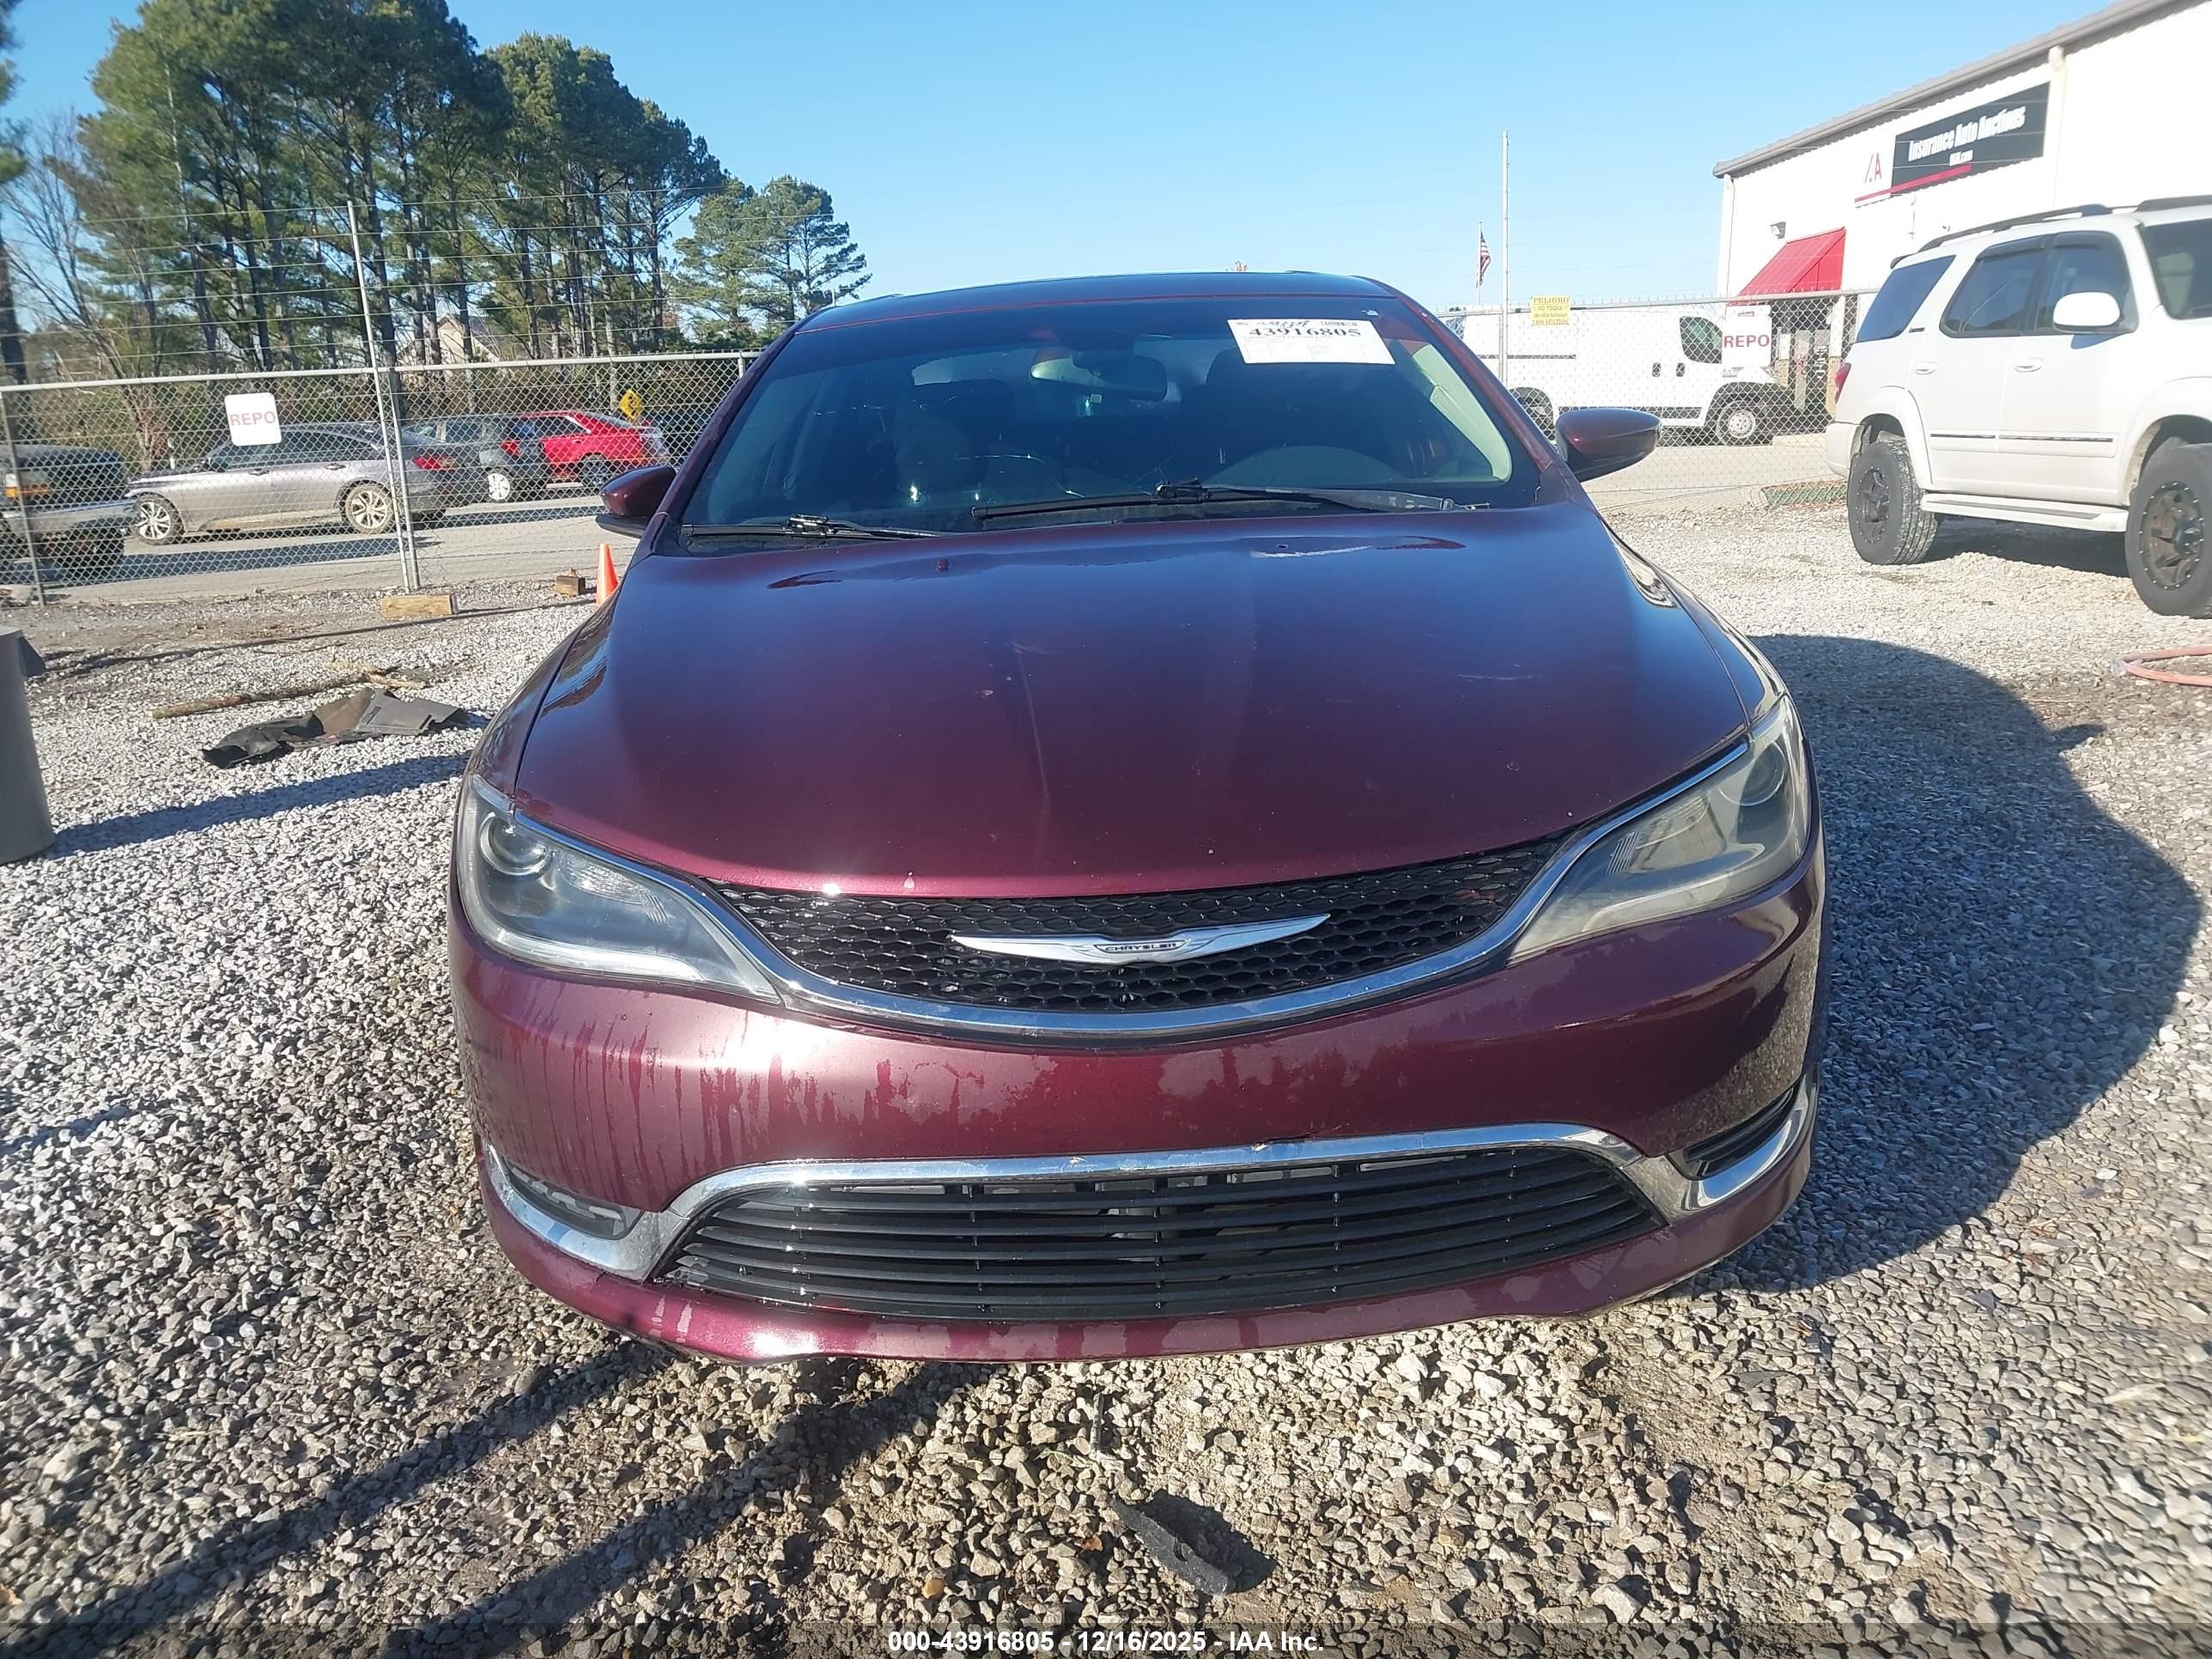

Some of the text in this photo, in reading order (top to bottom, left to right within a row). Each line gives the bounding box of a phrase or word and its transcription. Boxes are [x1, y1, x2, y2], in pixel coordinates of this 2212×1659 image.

[1908, 106, 2026, 161] Insurance Auto Auctions
[1249, 327, 1362, 337] 43916805
[1723, 334, 1770, 348] REPO
[229, 410, 276, 427] REPO
[1105, 943, 1177, 951] CHRYSLER
